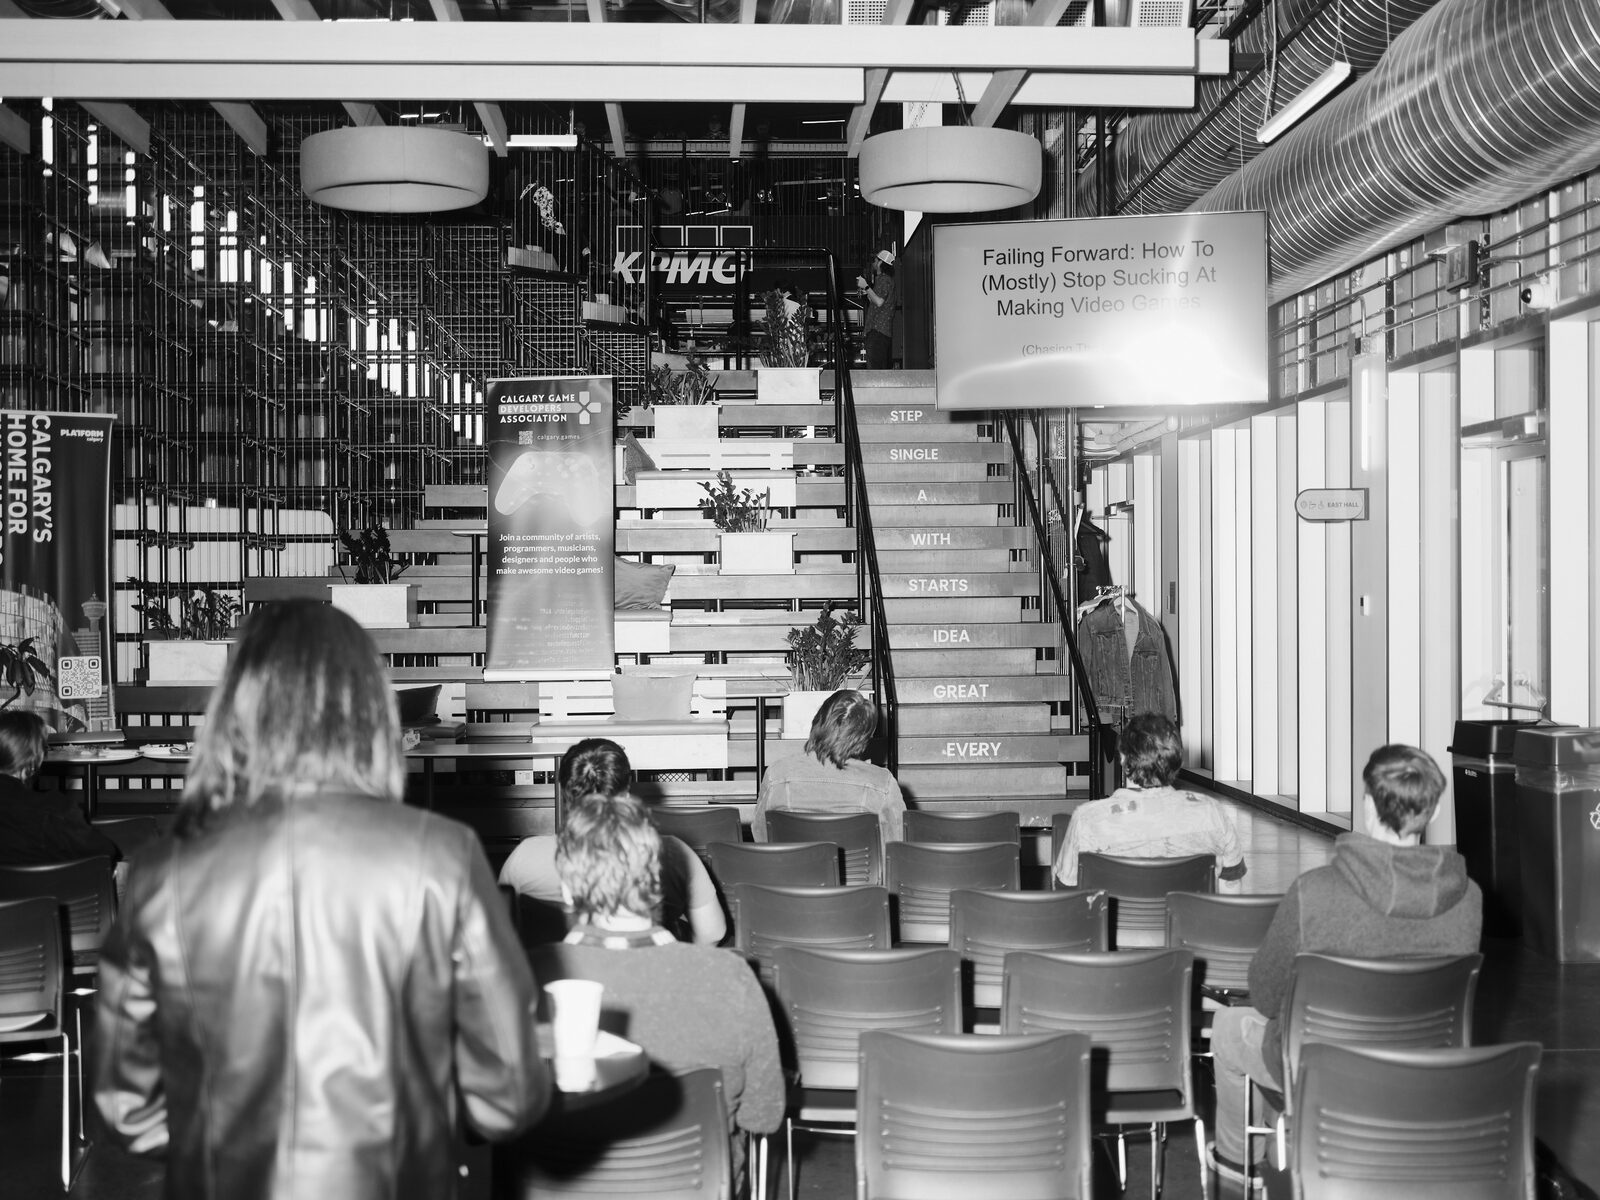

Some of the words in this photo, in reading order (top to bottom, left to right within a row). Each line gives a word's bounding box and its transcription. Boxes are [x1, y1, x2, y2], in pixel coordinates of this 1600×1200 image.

[983, 249, 1045, 267] Failing
[1052, 243, 1135, 263] Forward:
[1142, 242, 1185, 259] How
[1192, 240, 1215, 257] To
[612, 251, 747, 284] KPMG
[981, 272, 1056, 295] (Mostly)
[1063, 271, 1106, 291] Stop
[1113, 268, 1189, 288] Sucking
[1195, 266, 1217, 283] At
[997, 299, 1064, 318] Making
[1071, 296, 1125, 313] Video
[500, 395, 545, 403] CALGARY
[548, 394, 575, 402] GAME
[500, 404, 562, 413] DEVELOPERS
[500, 414, 567, 423] ASSOCIATION
[890, 410, 923, 422] STEP
[60, 428, 104, 438] PLATFORM
[7, 414, 27, 482] HOME
[890, 449, 938, 460] SINGLE
[32, 415, 53, 543] CALGARY'S
[917, 490, 928, 501] A
[8, 489, 27, 535] FOR
[522, 533, 564, 542] community
[565, 533, 574, 541] of
[574, 533, 601, 541] artists,
[911, 533, 951, 545] WITH
[503, 545, 556, 553] programmers,
[557, 544, 597, 552] musicians,
[502, 555, 538, 564] designers
[539, 555, 554, 563] and
[554, 555, 580, 564] people
[496, 567, 516, 575] make
[554, 566, 575, 574] video
[576, 566, 604, 575] games!
[908, 579, 968, 592] STARTS
[933, 629, 970, 643] IDEA
[933, 684, 990, 698] GREAT
[946, 742, 1001, 757] EVERY
